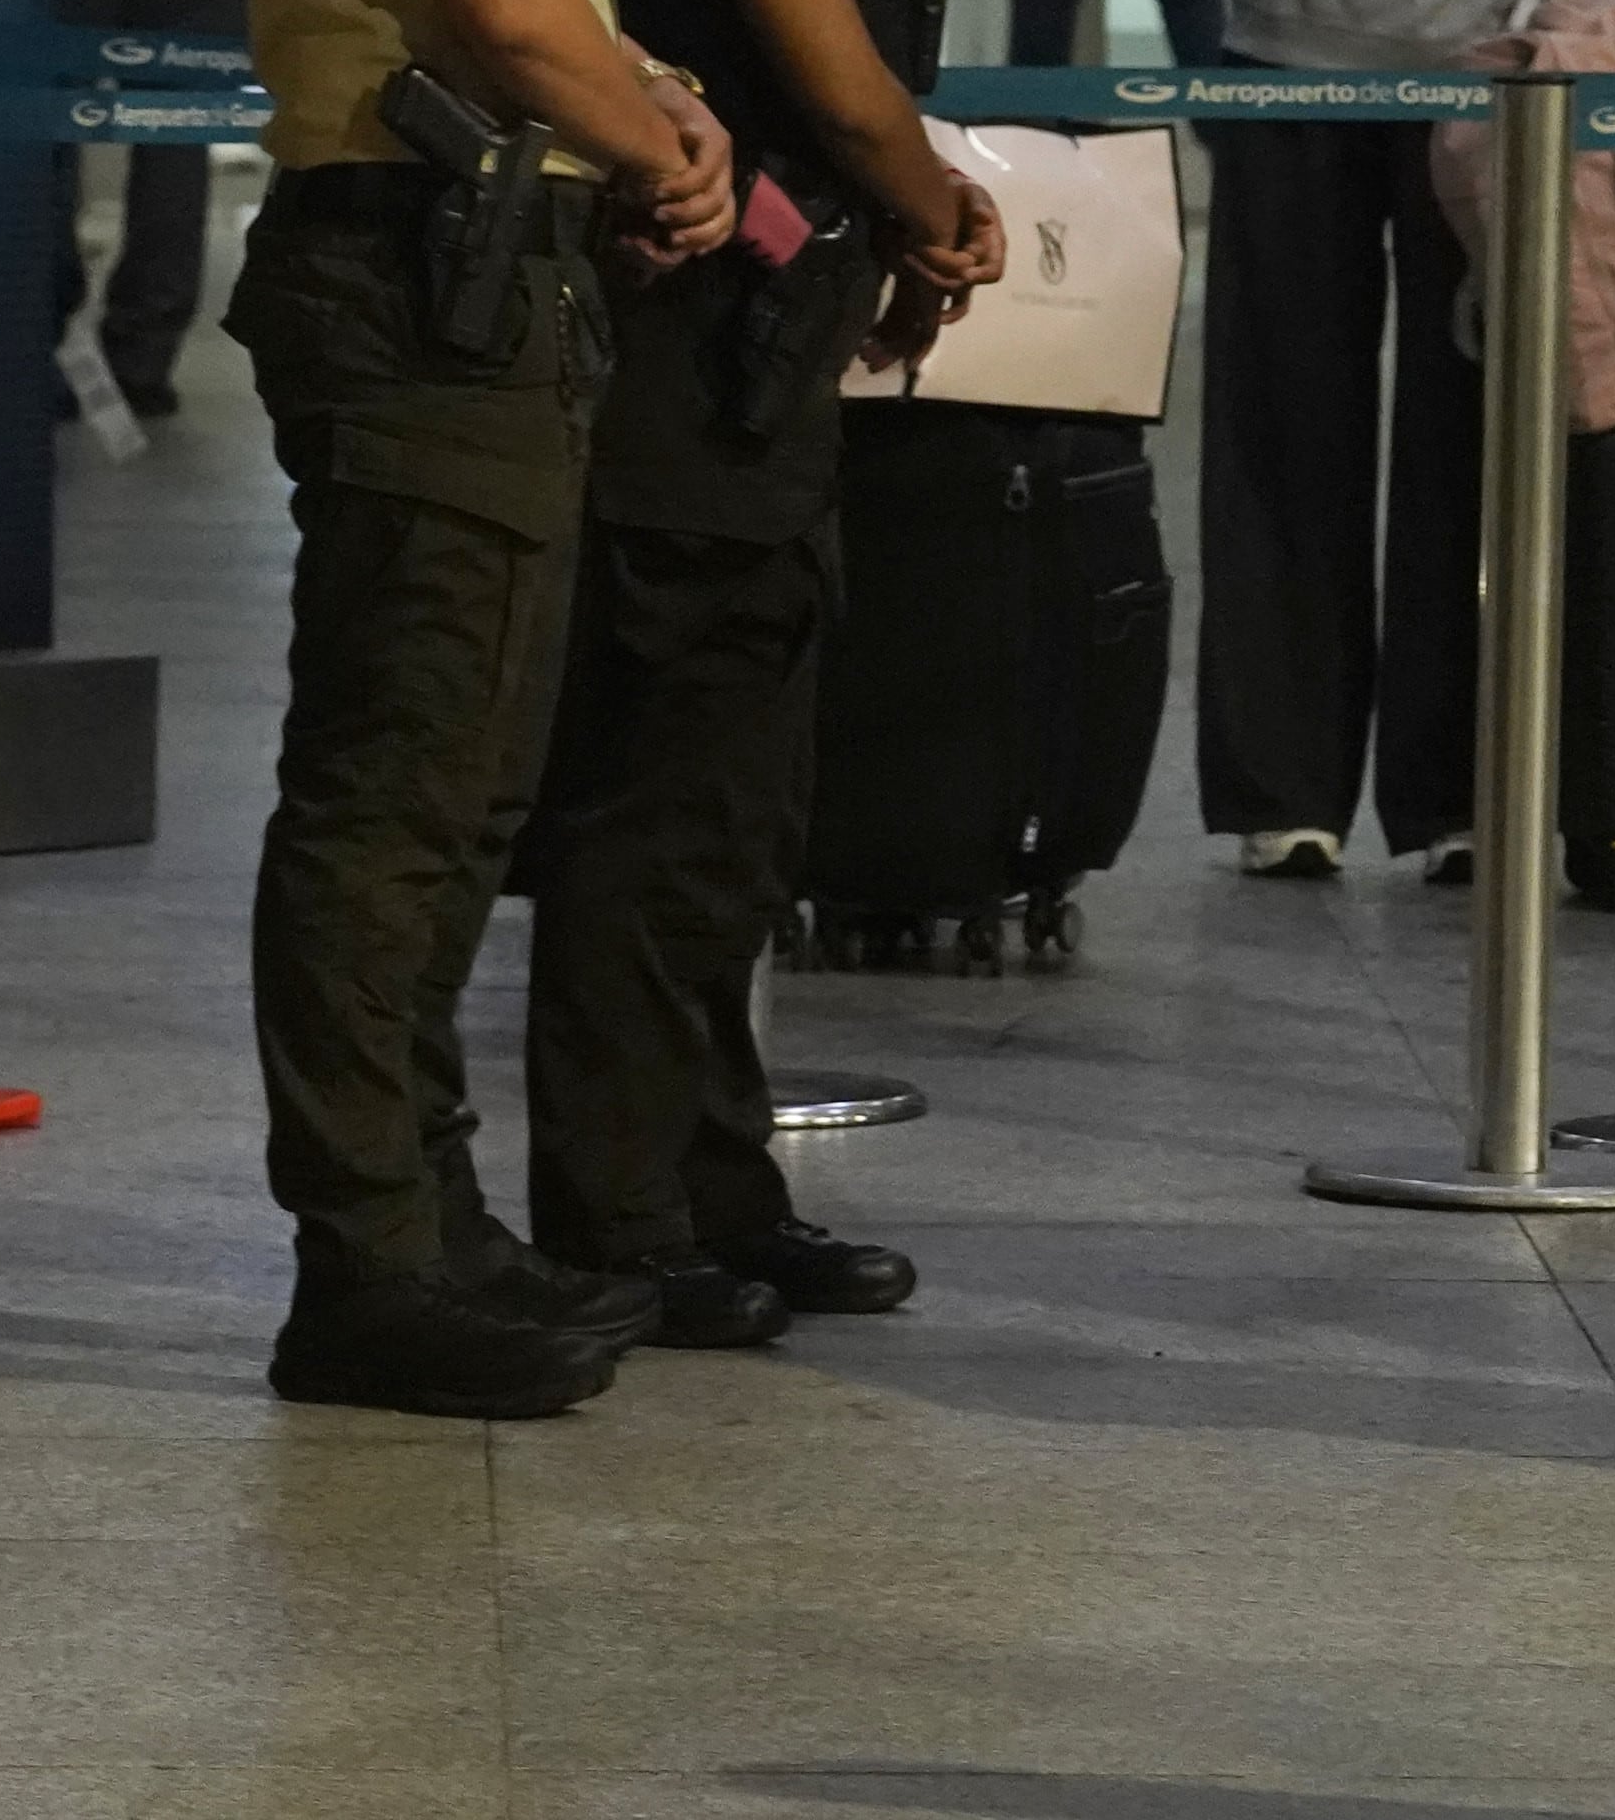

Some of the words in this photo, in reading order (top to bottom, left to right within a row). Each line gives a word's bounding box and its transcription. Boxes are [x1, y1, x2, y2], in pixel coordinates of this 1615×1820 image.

[161, 41, 253, 76] Aeropu
[1187, 79, 1357, 108] Aeropuerto
[1397, 79, 1493, 110] Guaya
